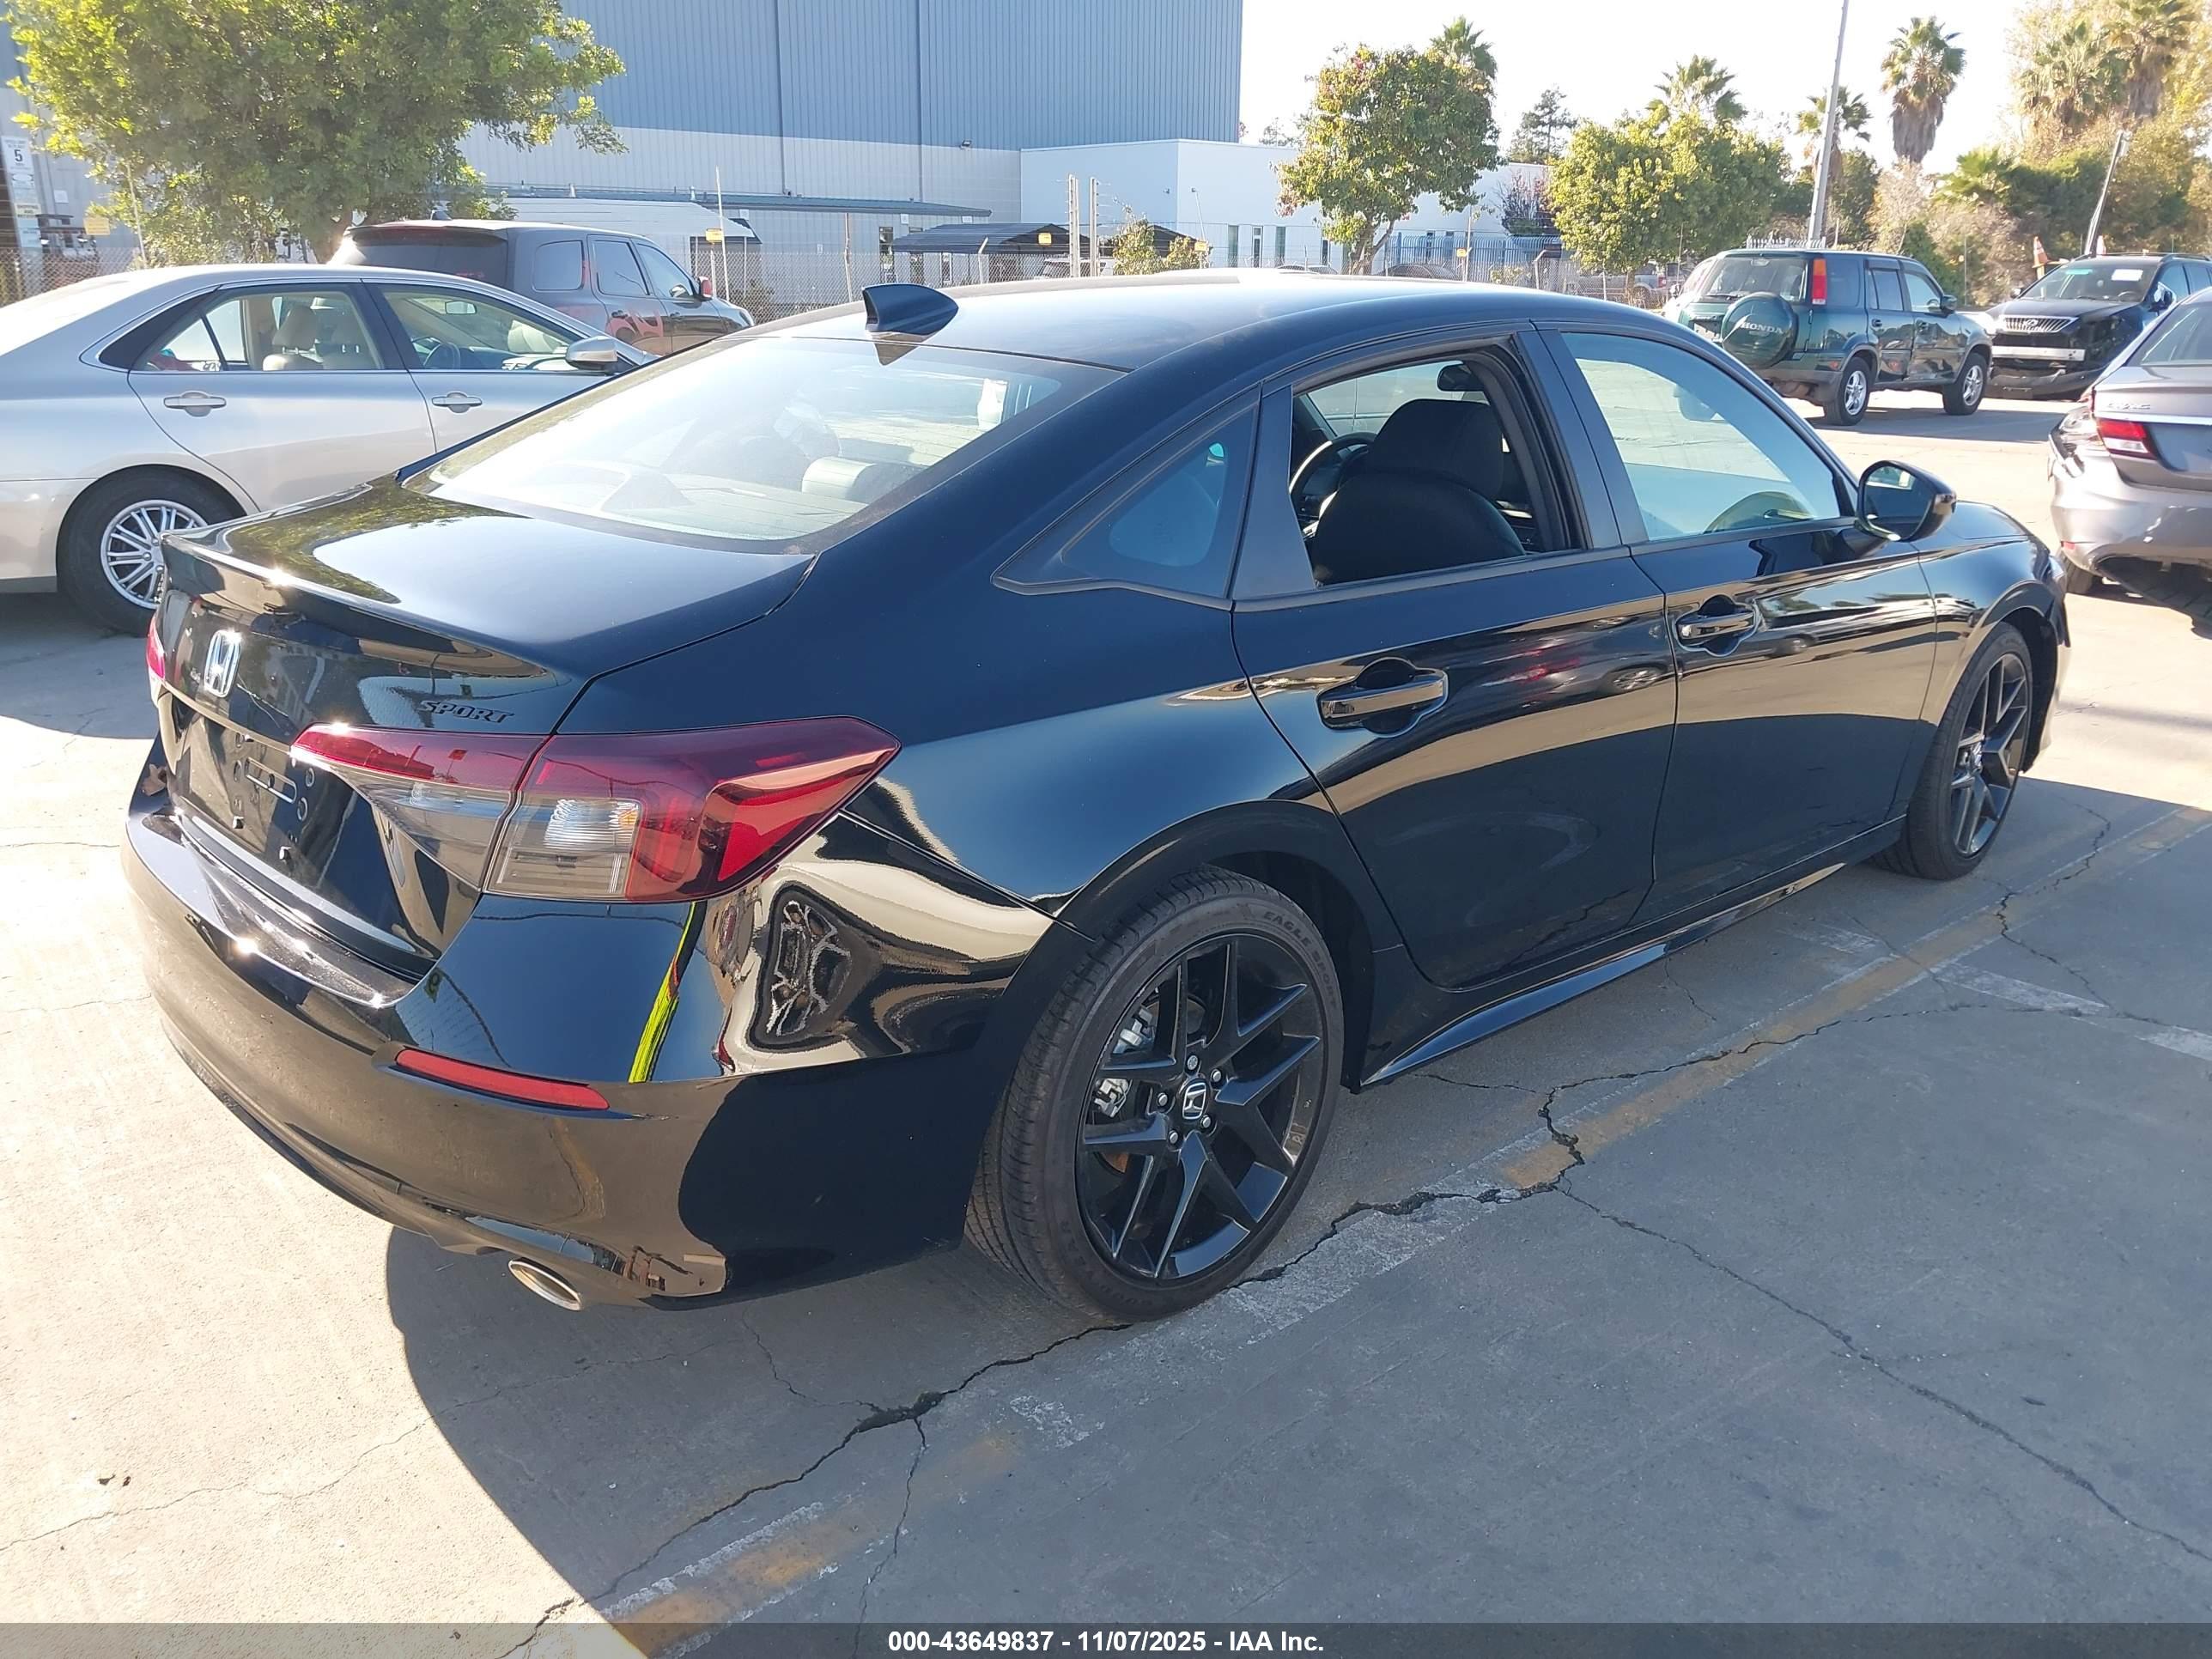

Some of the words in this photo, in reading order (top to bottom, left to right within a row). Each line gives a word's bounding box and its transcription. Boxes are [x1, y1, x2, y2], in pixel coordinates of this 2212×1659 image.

[14, 149, 23, 162] 5
[1740, 321, 1784, 334] HONDA
[416, 700, 515, 723] SPORT
[1263, 911, 1312, 947] EAGLE
